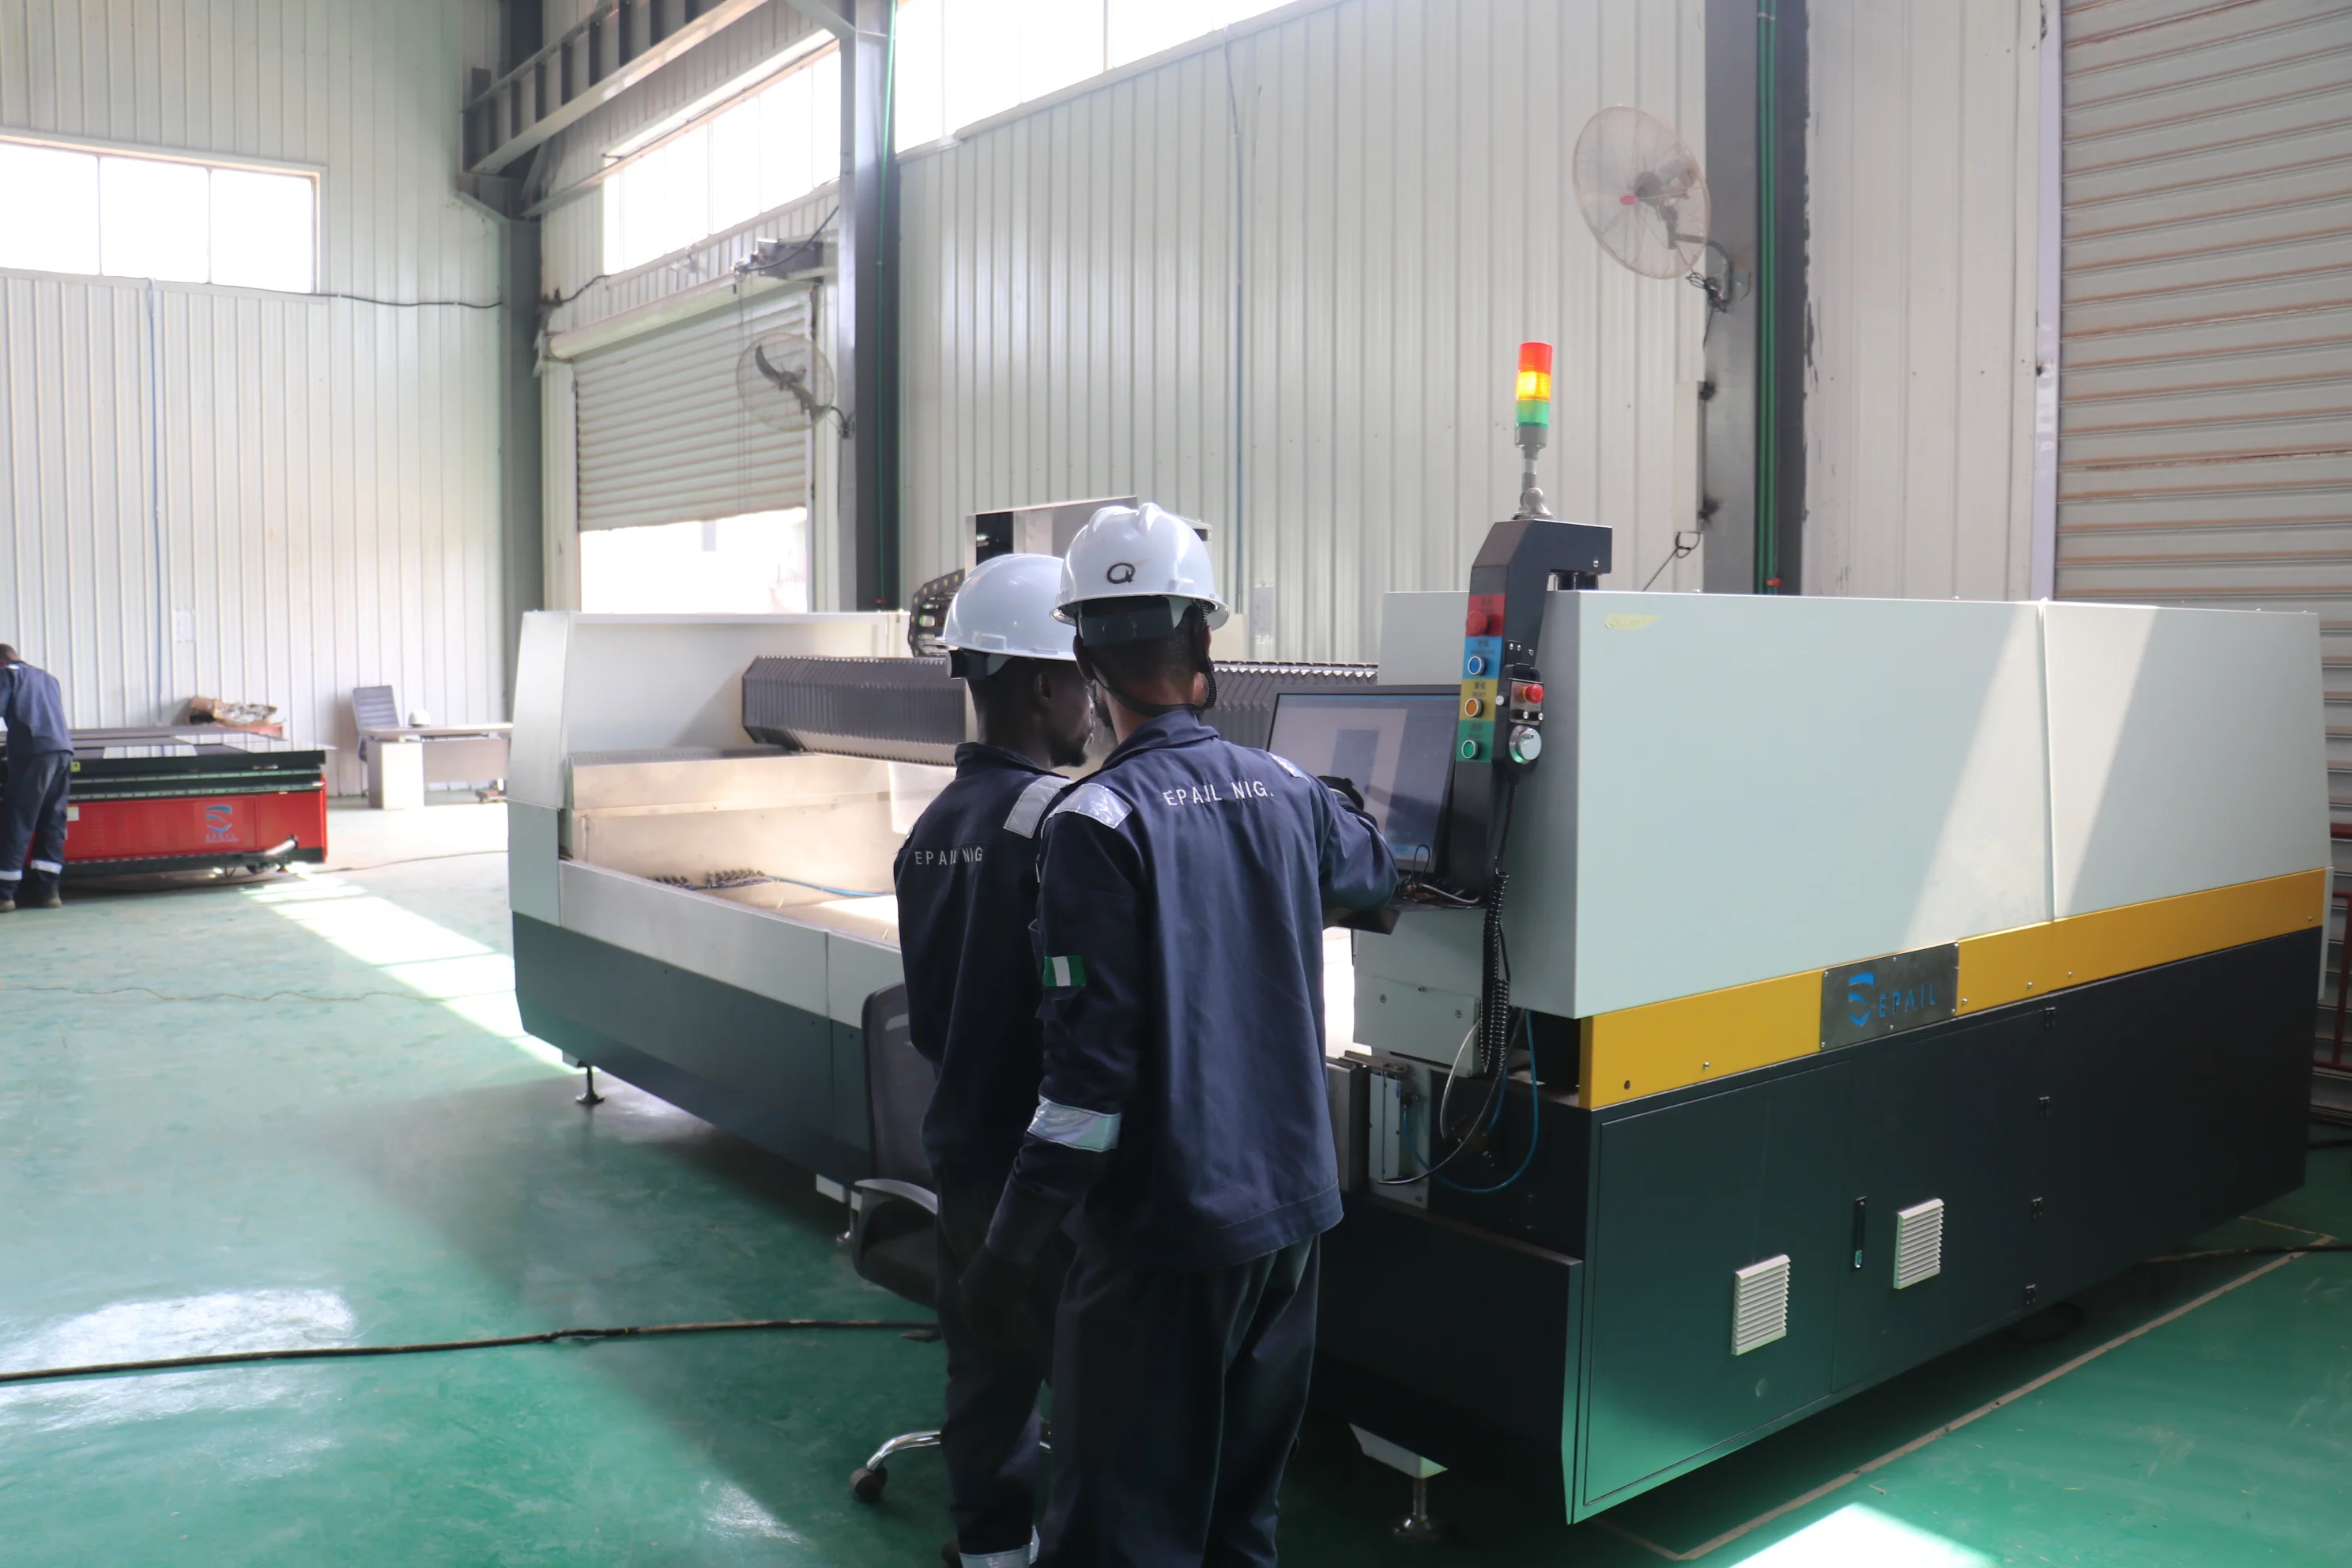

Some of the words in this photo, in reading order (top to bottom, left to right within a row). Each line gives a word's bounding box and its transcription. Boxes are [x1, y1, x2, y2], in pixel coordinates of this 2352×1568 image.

[1162, 783, 1223, 806] EPAIL
[1231, 781, 1274, 800] NIG.
[914, 850, 957, 865] EPAIL
[962, 846, 983, 863] NIG
[1879, 983, 1936, 1017] EPAIL
